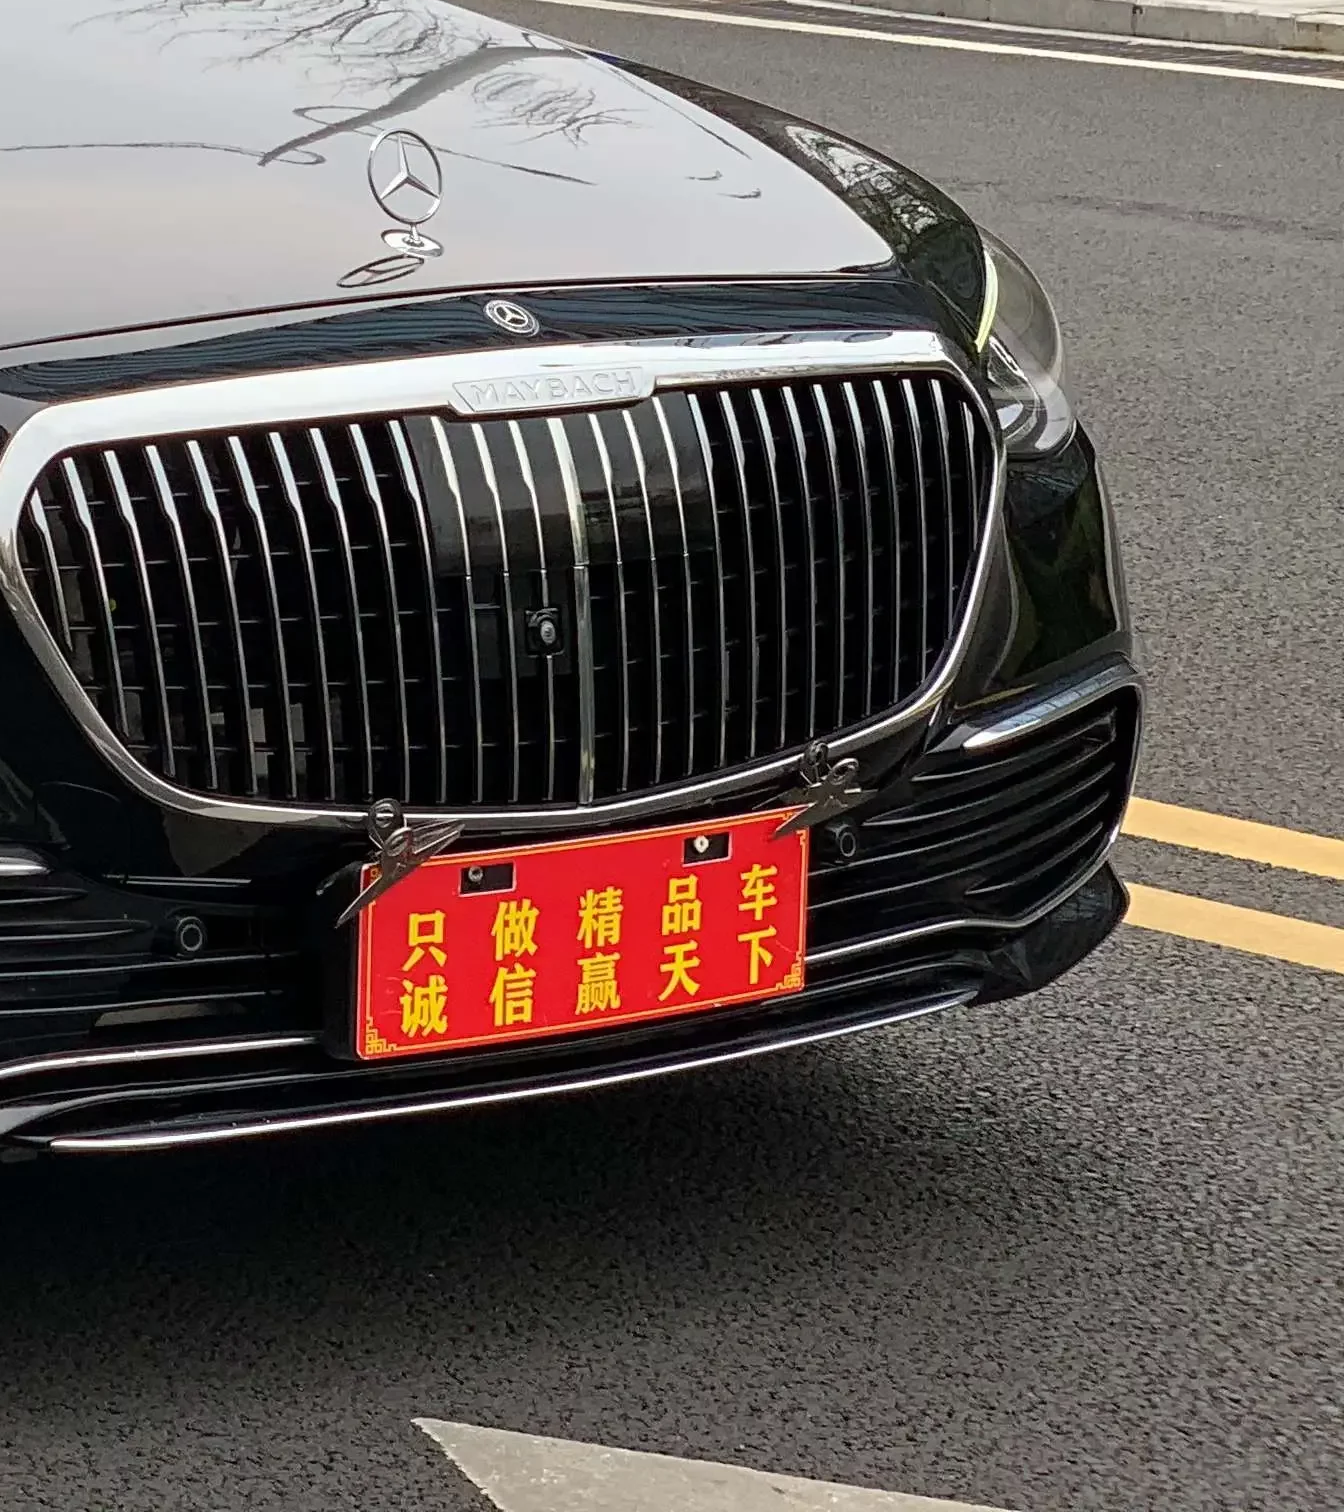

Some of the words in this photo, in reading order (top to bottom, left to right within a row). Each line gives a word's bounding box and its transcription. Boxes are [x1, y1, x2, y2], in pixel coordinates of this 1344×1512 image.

[470, 370, 637, 405] MAYBACH
[401, 863, 779, 972] 只做精品车
[399, 925, 778, 1038] 诚信赢天下
